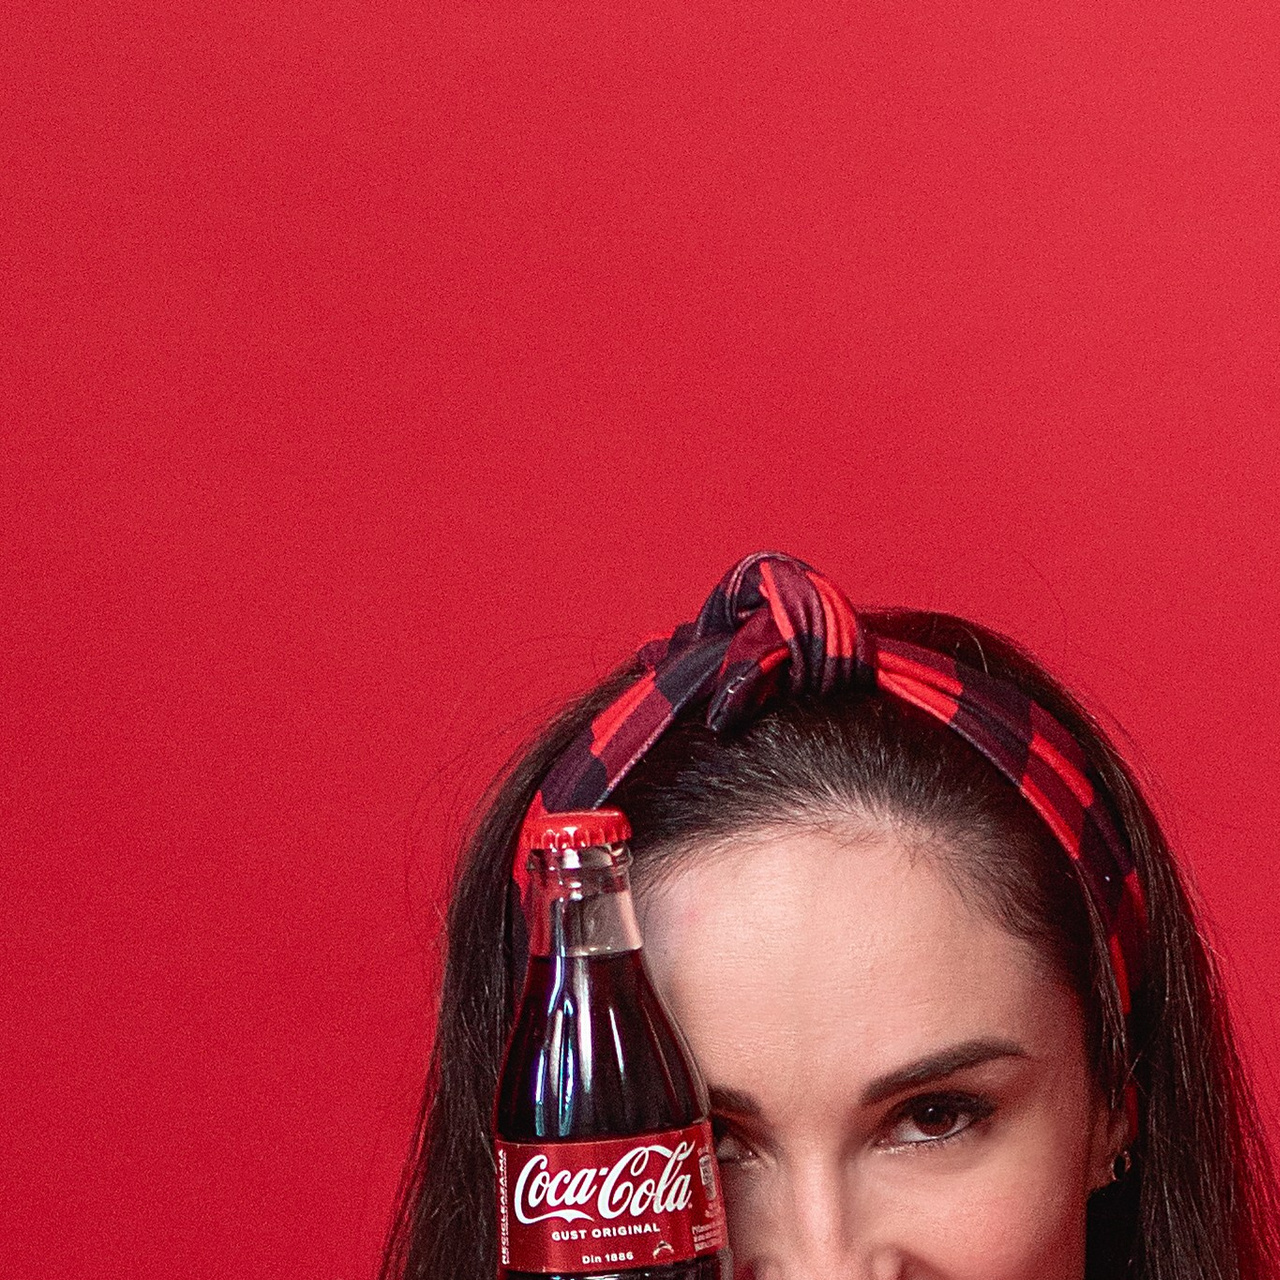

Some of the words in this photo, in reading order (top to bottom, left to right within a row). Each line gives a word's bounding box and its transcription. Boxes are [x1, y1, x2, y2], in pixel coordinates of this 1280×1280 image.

[514, 1140, 695, 1224] Coca-Cola
[551, 1229, 587, 1241] GUST
[591, 1223, 660, 1238] ORIGINAL
[582, 1255, 601, 1264] Din
[605, 1251, 634, 1262] 1886
